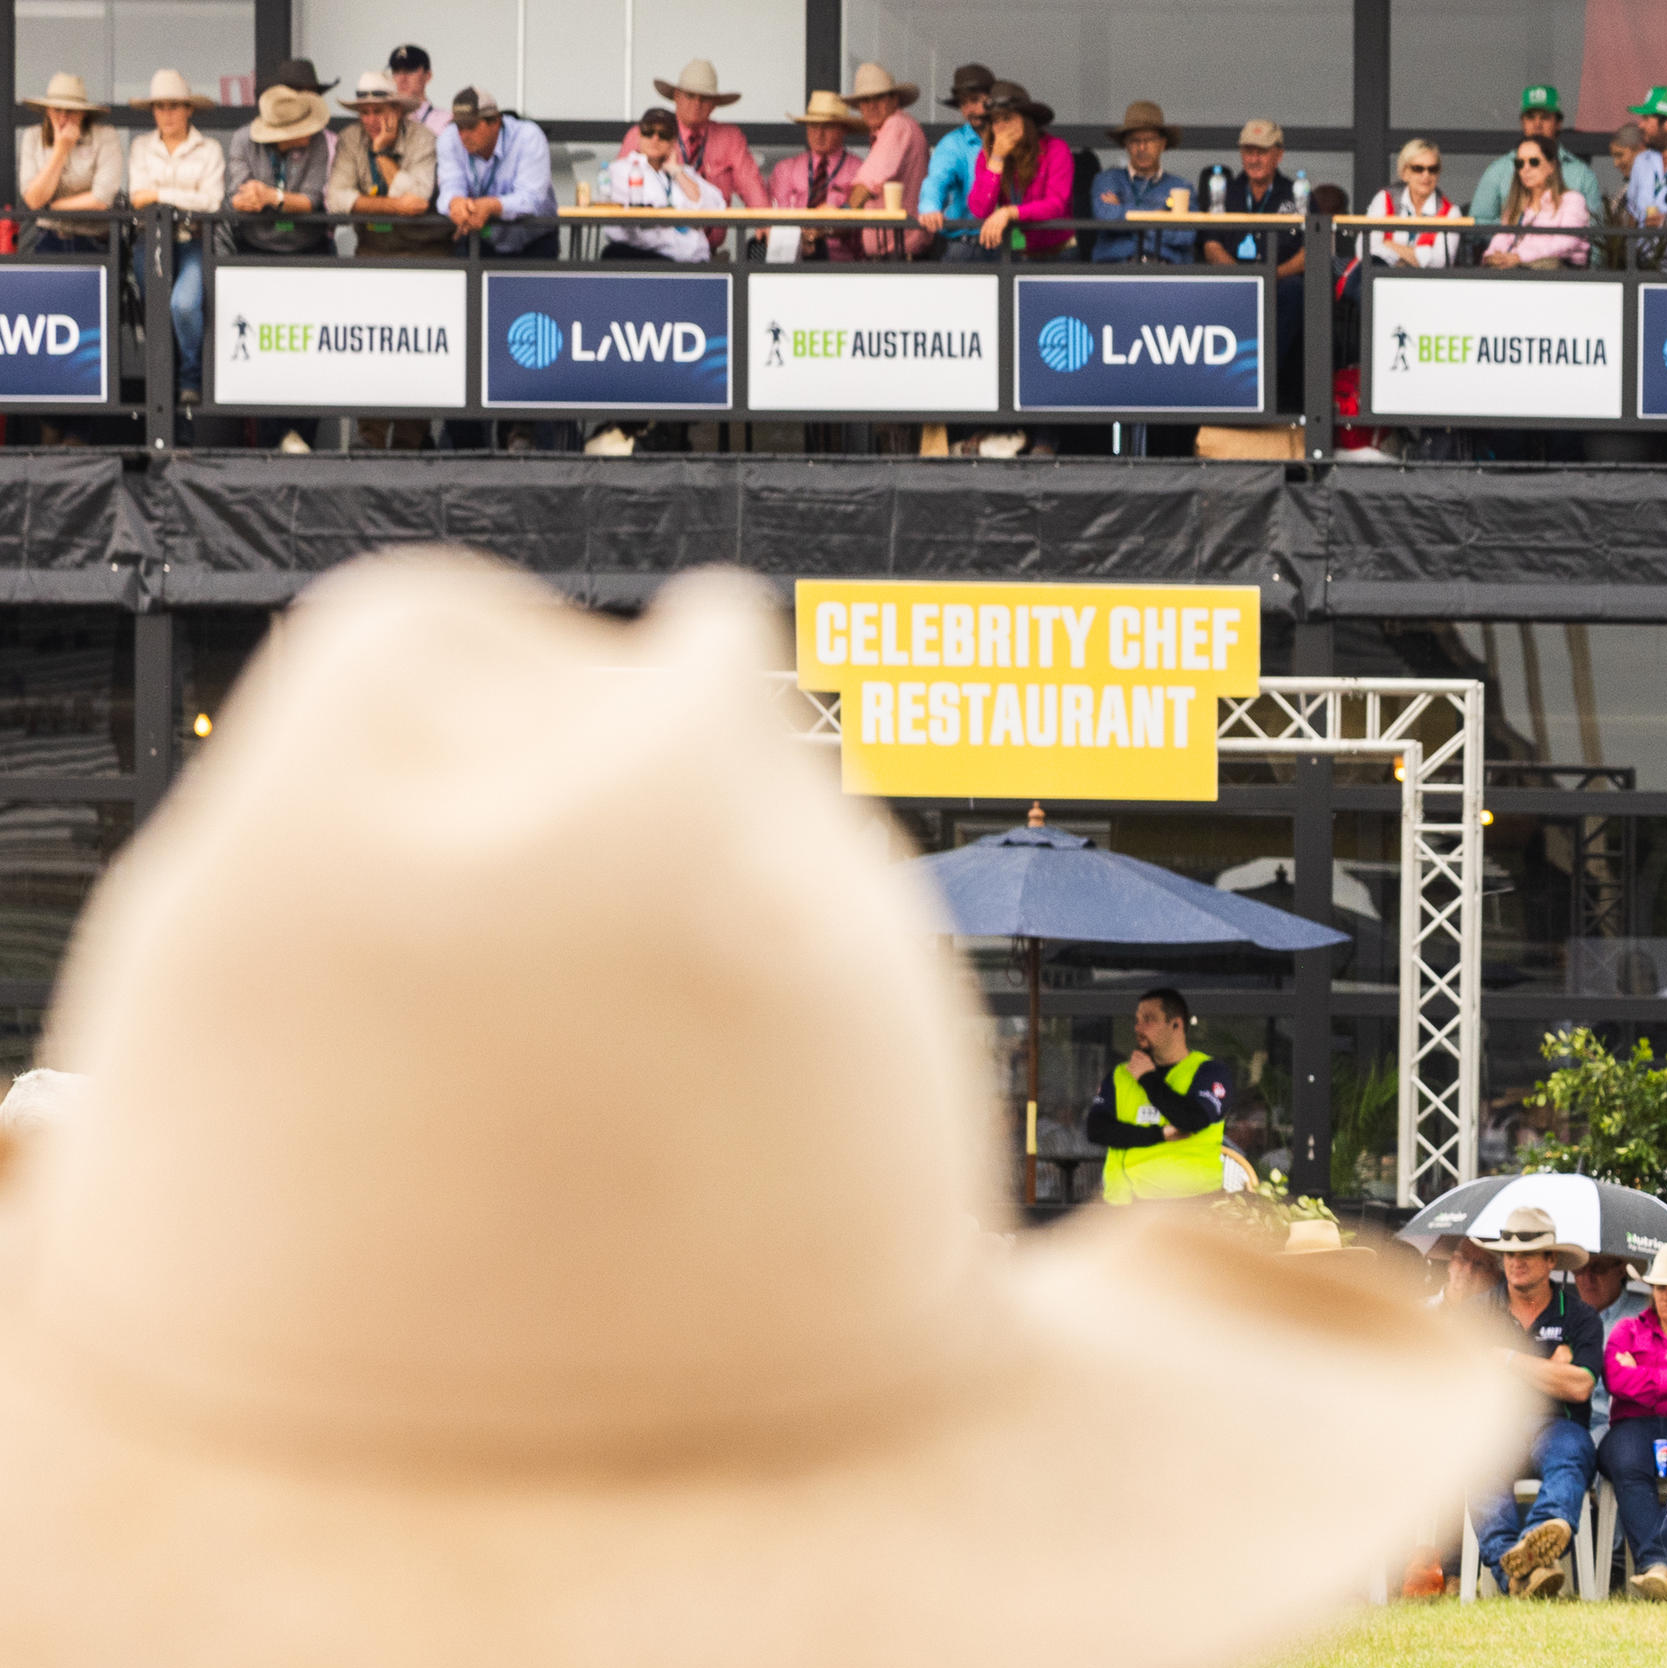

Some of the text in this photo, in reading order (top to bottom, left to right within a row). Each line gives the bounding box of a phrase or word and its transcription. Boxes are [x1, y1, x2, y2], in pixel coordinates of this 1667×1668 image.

[0, 313, 80, 355] WD
[260, 325, 448, 353] BEEF AUSTRALIA
[571, 321, 706, 363] LAWD
[793, 331, 982, 358] BEEF AUSTRALIA
[1102, 325, 1238, 365] LAWD
[1418, 335, 1606, 365] BEEF AUSTRALIA
[815, 601, 1240, 670] CELEBRITY CHEF
[861, 681, 1196, 749] RESTAURANT
